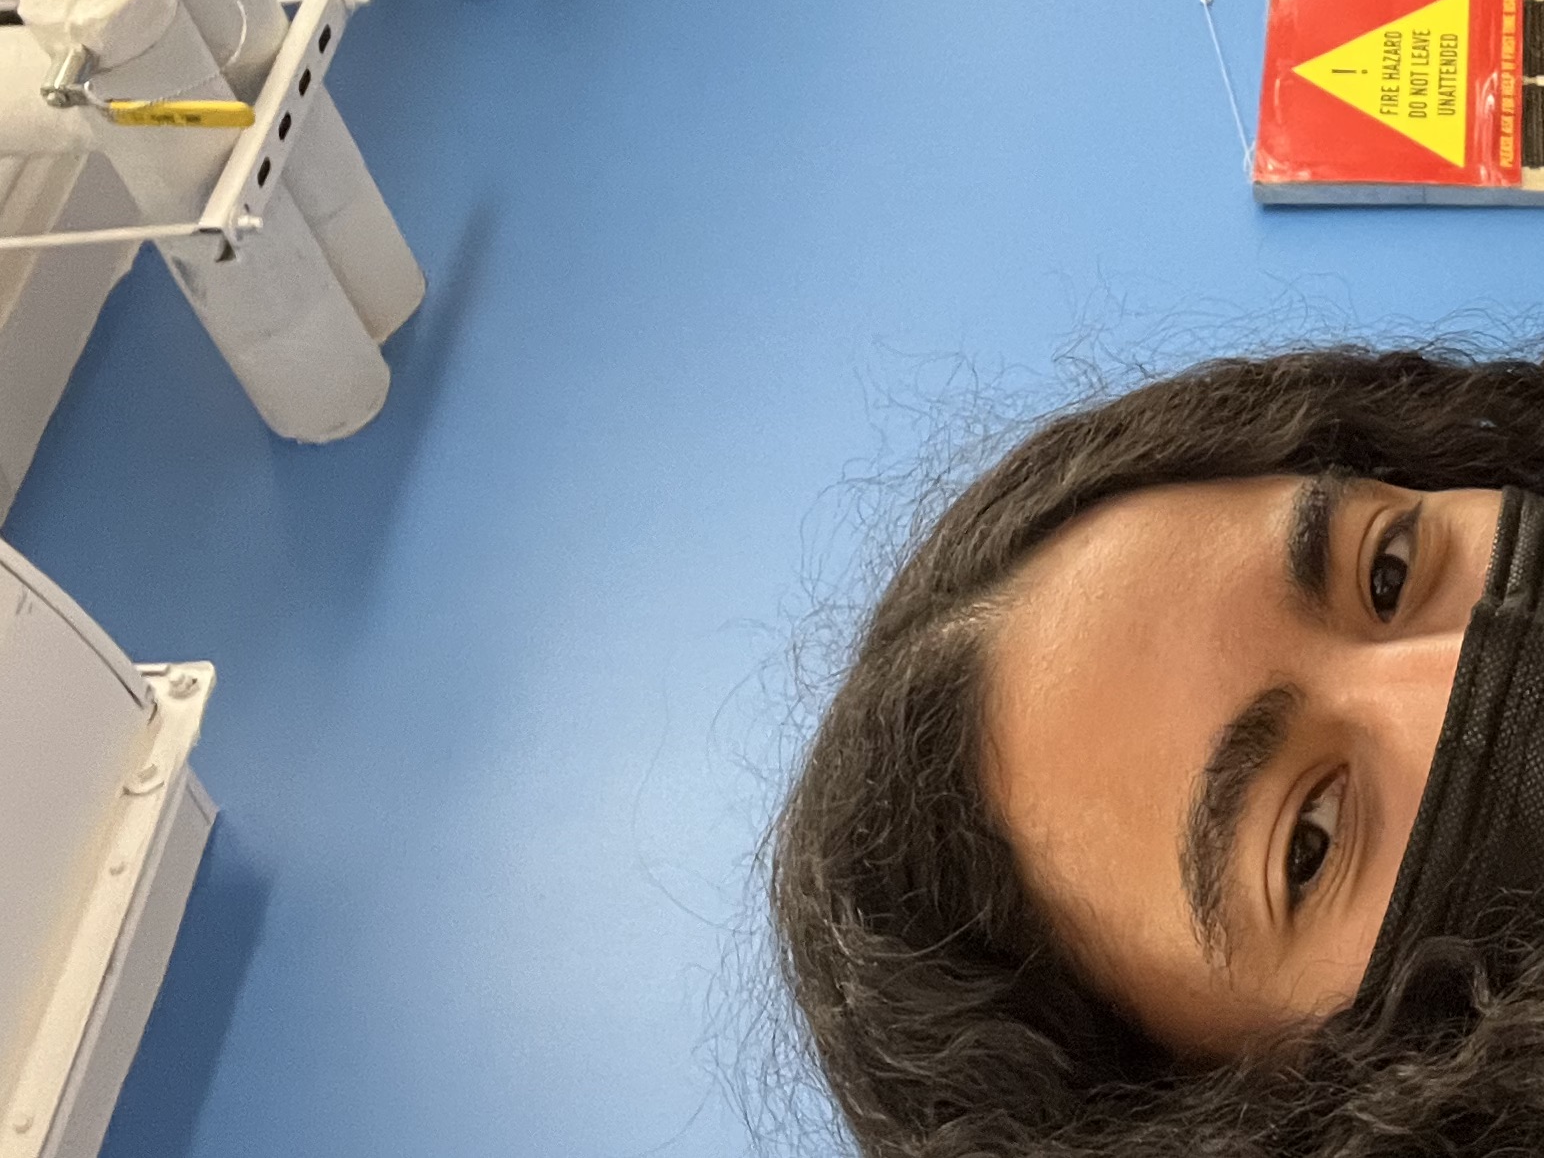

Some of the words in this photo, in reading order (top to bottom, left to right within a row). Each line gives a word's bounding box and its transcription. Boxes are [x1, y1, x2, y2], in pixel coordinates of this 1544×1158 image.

[1381, 31, 1402, 81] HAZARD
[1410, 28, 1431, 66] LEAVE
[1409, 71, 1429, 97] NOT
[1437, 33, 1458, 116] UNATTENDED
[1379, 85, 1400, 116] FIRE
[1408, 101, 1427, 119] DO
